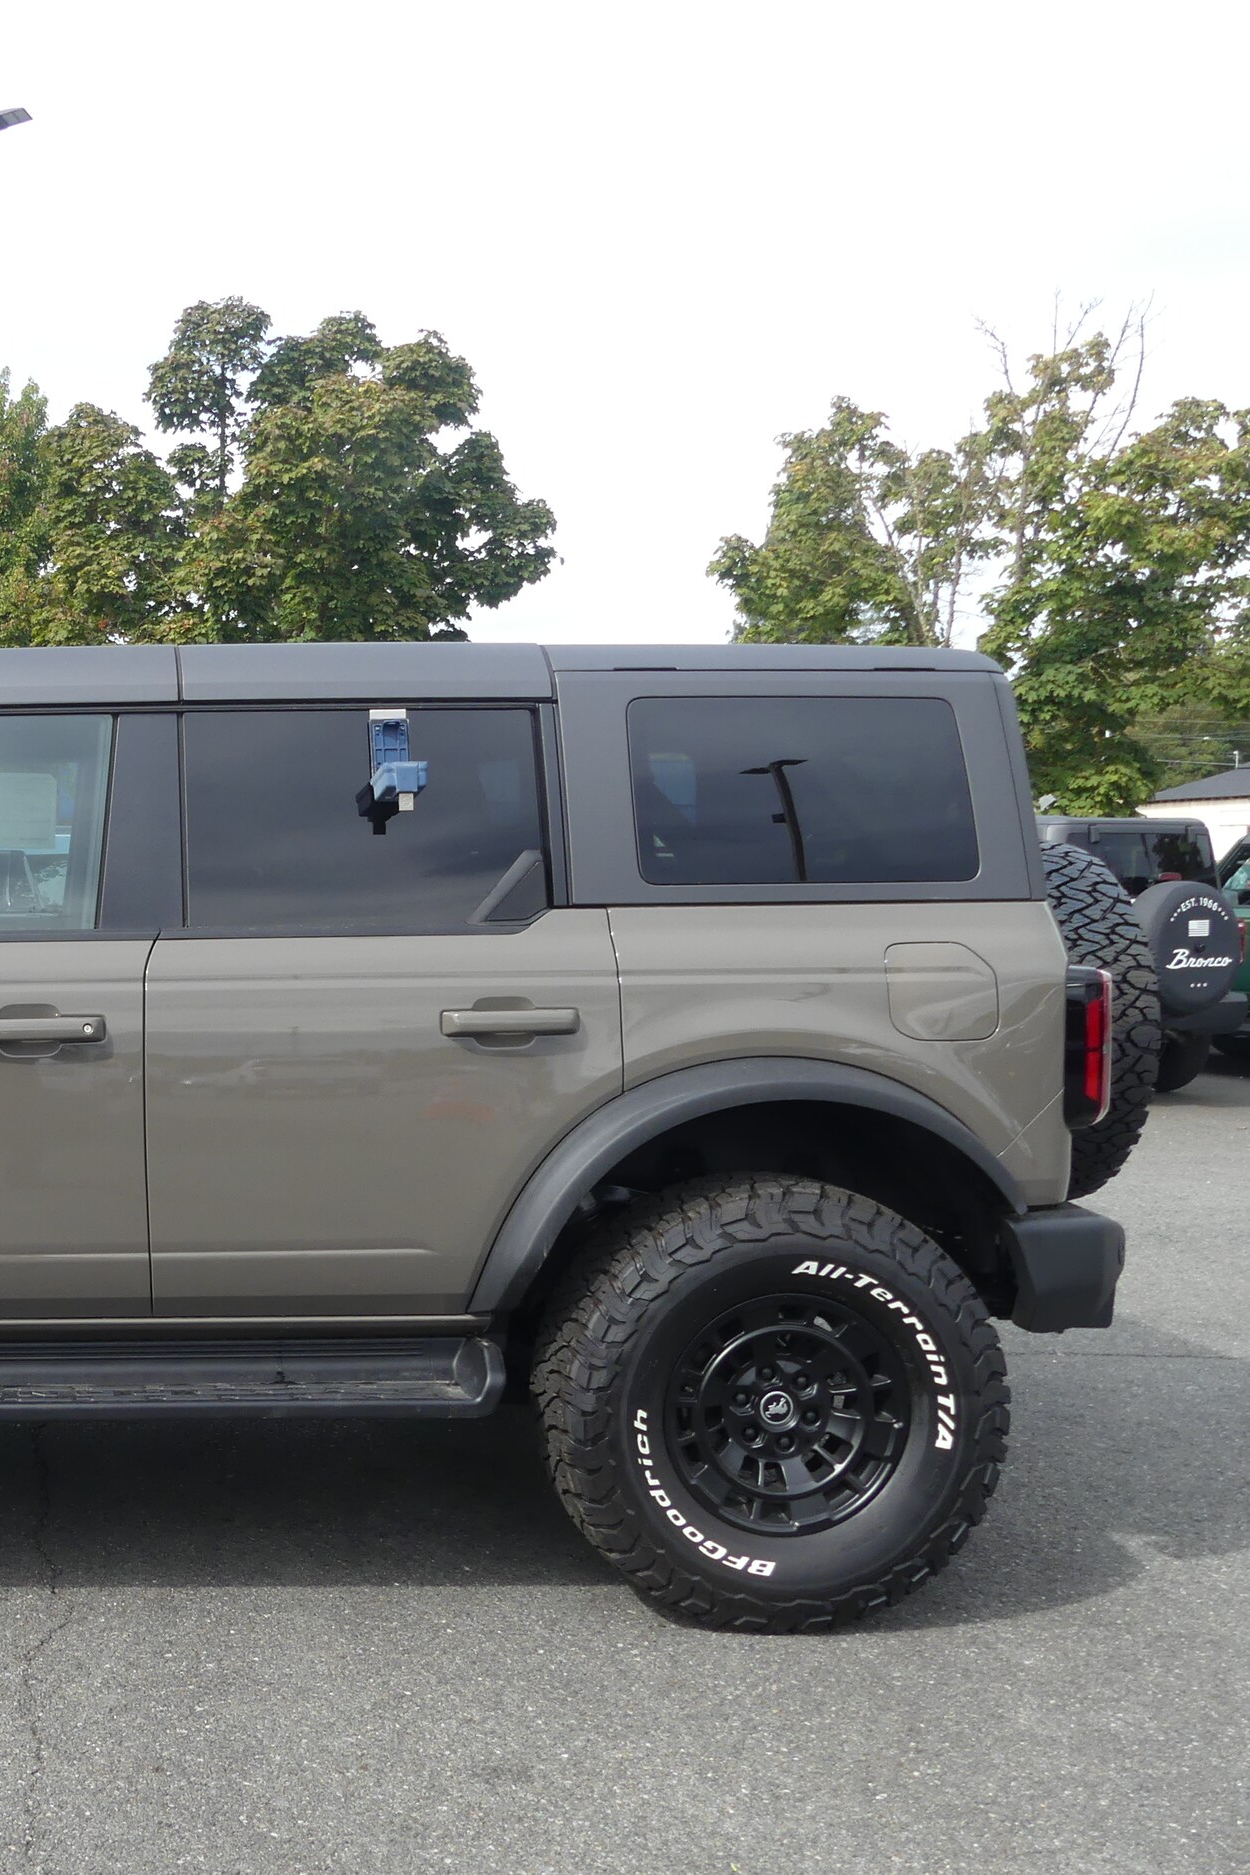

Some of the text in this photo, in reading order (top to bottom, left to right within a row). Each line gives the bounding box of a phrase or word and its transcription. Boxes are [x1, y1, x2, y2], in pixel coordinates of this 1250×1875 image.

[1181, 897, 1218, 912] EST. 1966
[1165, 948, 1233, 970] Bronco
[791, 1260, 956, 1450] All-Terrain T/A
[631, 1408, 776, 1579] BFGoodrich
